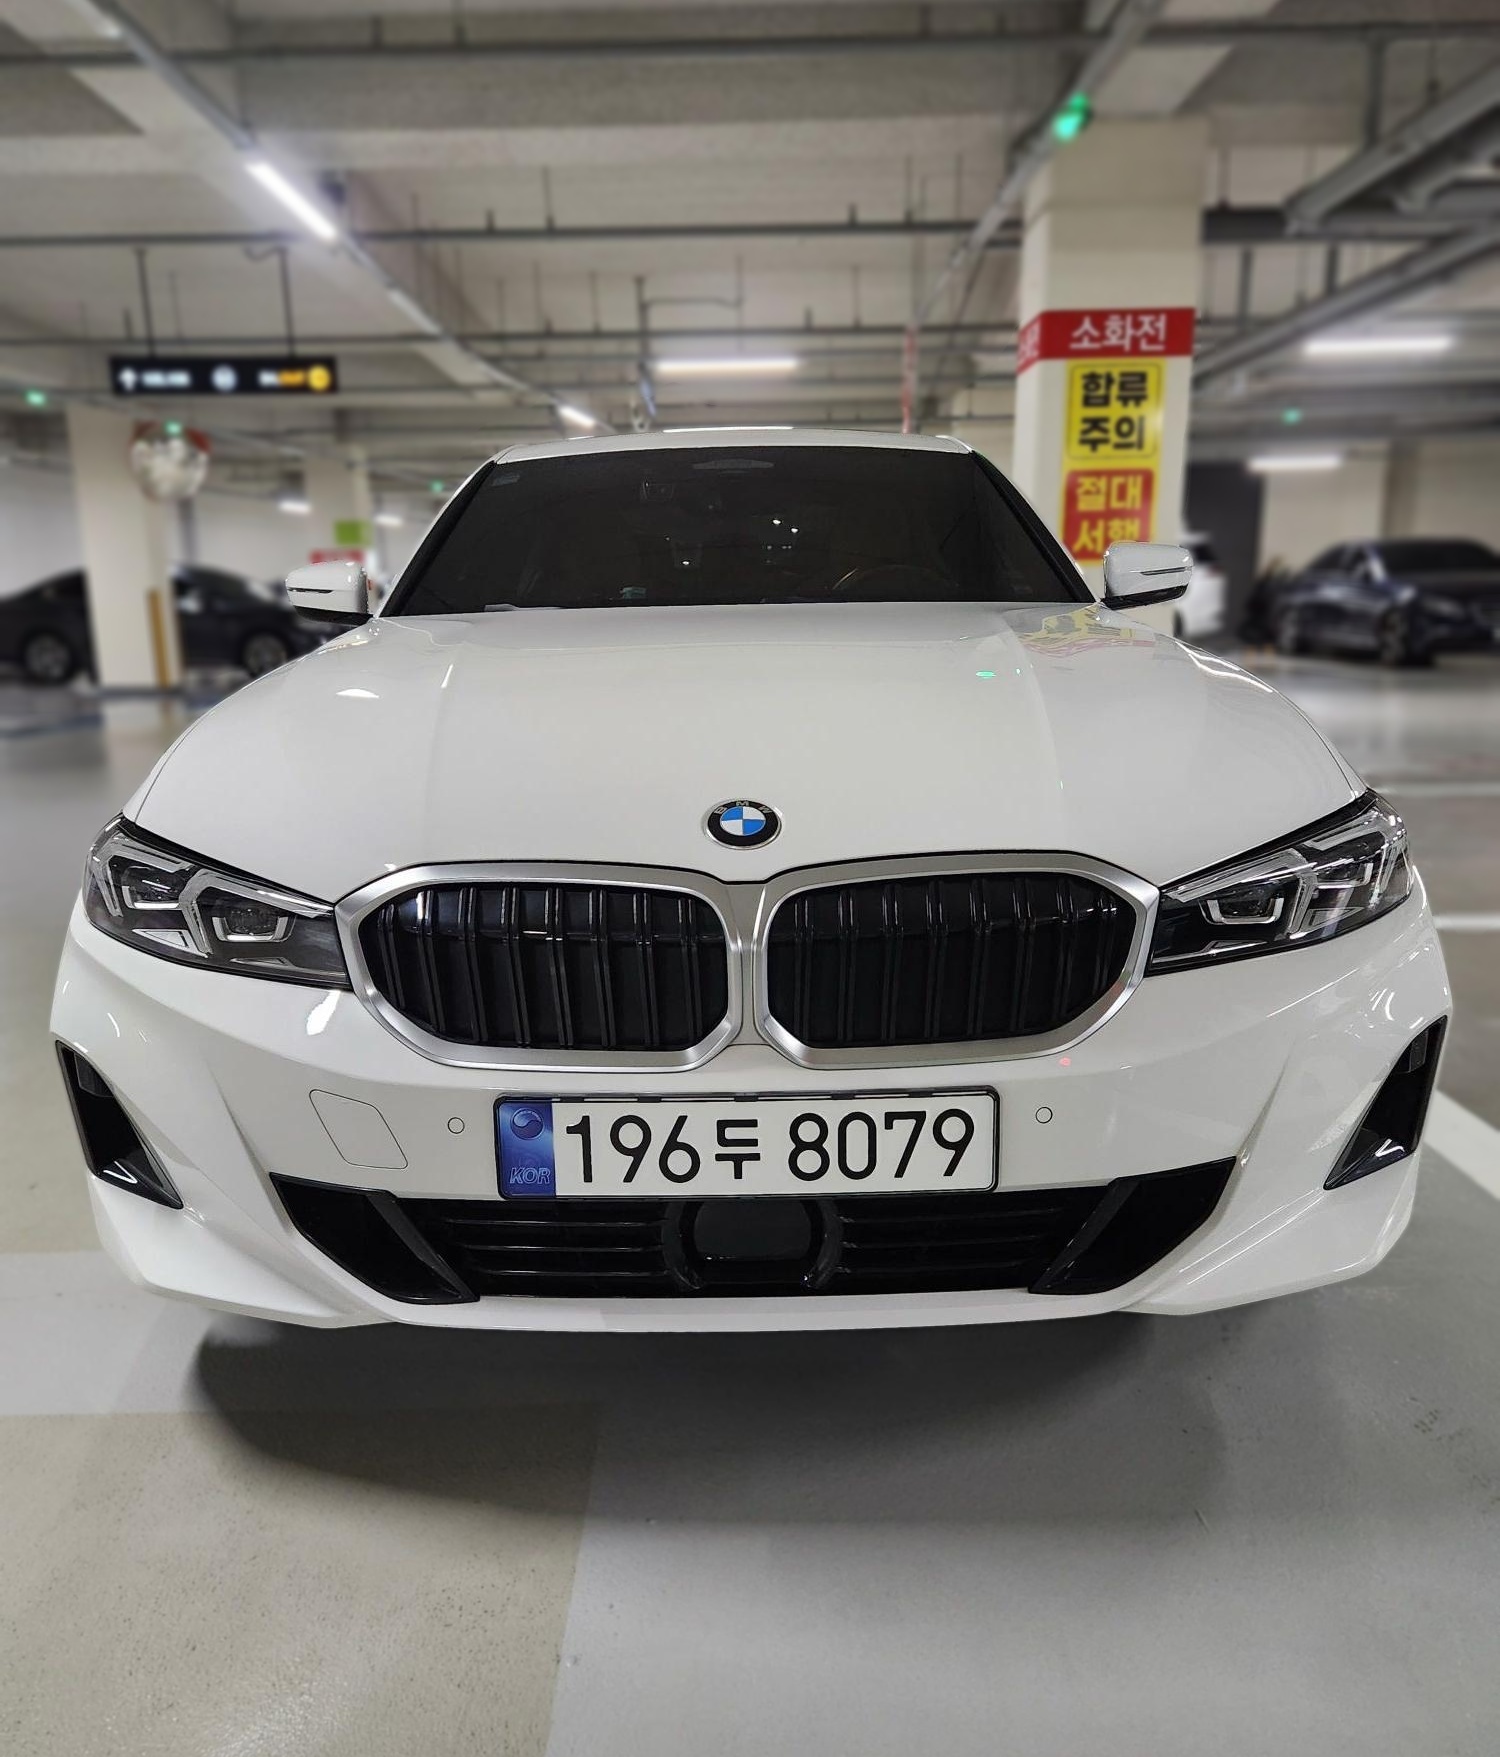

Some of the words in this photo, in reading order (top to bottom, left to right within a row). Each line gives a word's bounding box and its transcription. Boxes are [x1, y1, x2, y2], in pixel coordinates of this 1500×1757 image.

[1070, 314, 1167, 351] 소화전
[1082, 371, 1147, 408] 합류
[1079, 415, 1145, 453] 주의
[1076, 475, 1143, 511] 절대
[714, 800, 773, 815] BMW
[787, 1108, 976, 1182] 8079
[509, 1166, 551, 1184] KOR
